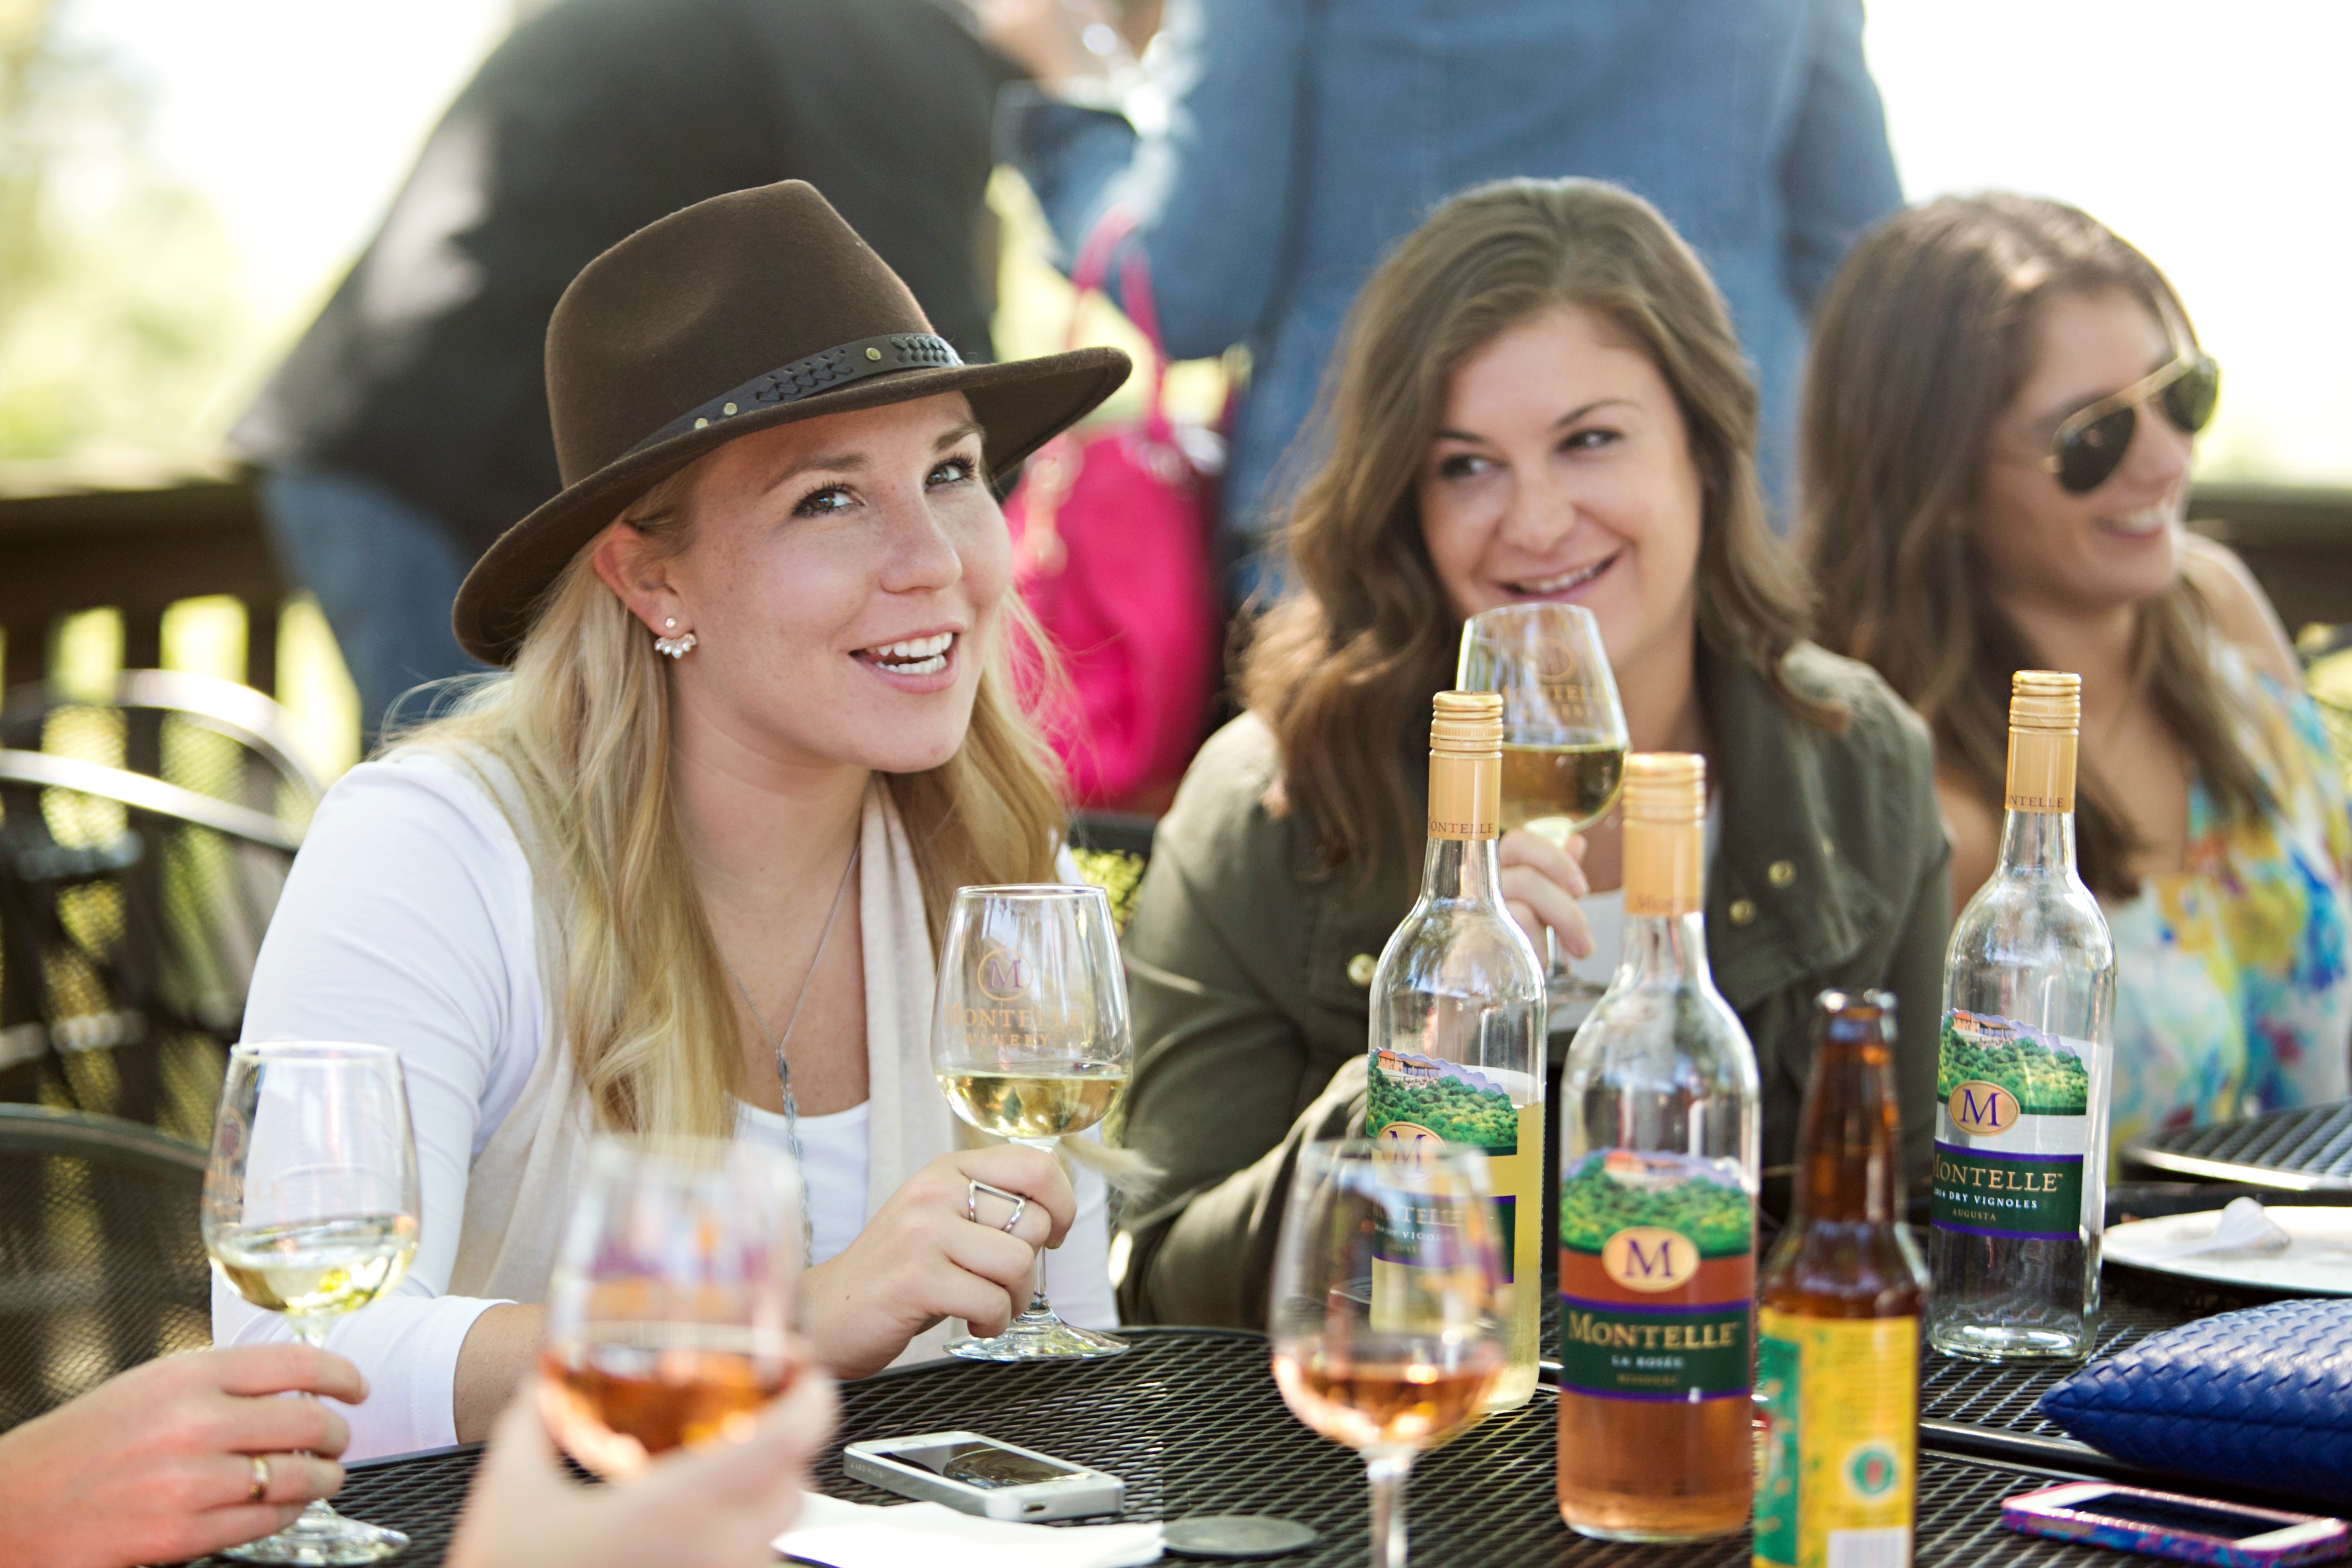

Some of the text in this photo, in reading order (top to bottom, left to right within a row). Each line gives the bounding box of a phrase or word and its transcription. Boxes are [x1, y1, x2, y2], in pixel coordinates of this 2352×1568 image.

[2005, 794, 2063, 808] ONTELLE
[1960, 1089, 2001, 1127] M
[1949, 1191, 1968, 1203] DRY
[1974, 1196, 2038, 1209] VIGNOLES
[1953, 1208, 1996, 1221] AUGUSTA
[1623, 1238, 1675, 1278] M
[1568, 1311, 1738, 1348] MONTELLE
